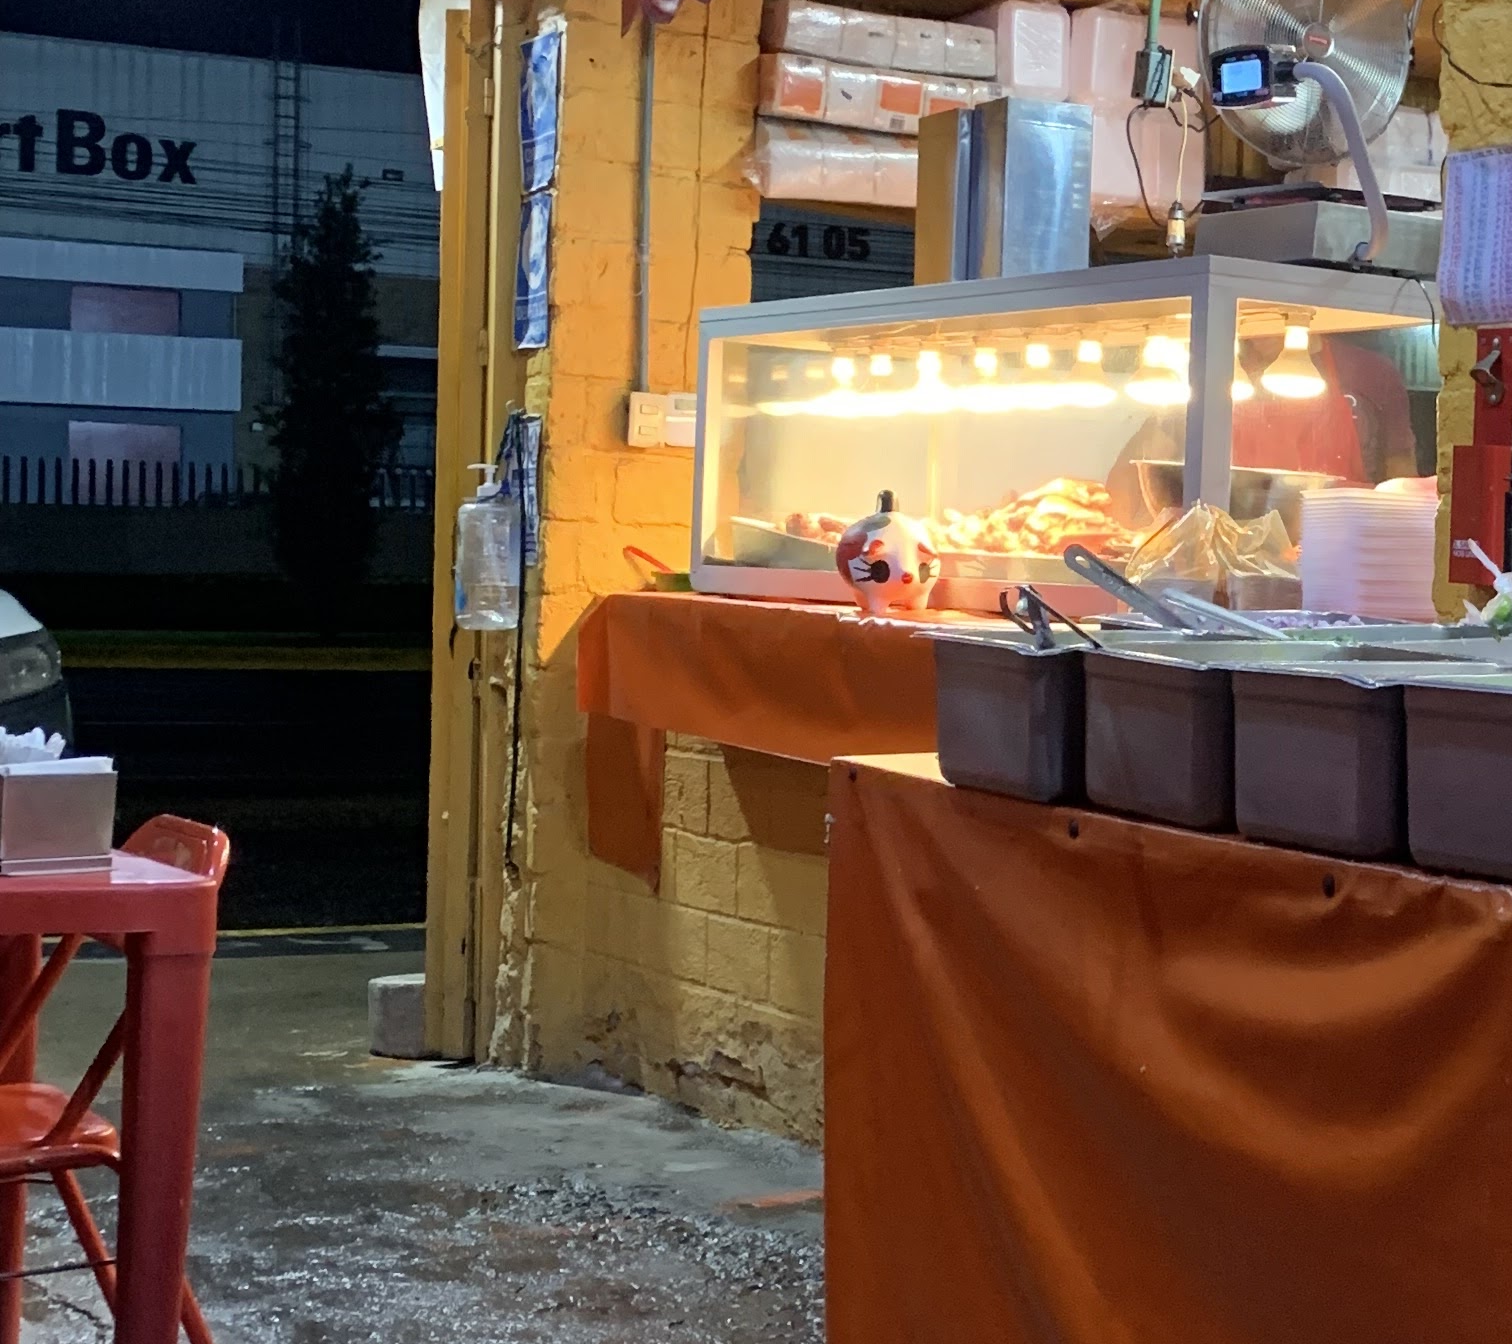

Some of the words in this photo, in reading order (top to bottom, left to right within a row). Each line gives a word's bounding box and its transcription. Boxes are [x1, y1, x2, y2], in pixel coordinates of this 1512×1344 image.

[56, 108, 197, 185] Box
[767, 222, 808, 257] 61
[822, 224, 871, 262] 05
